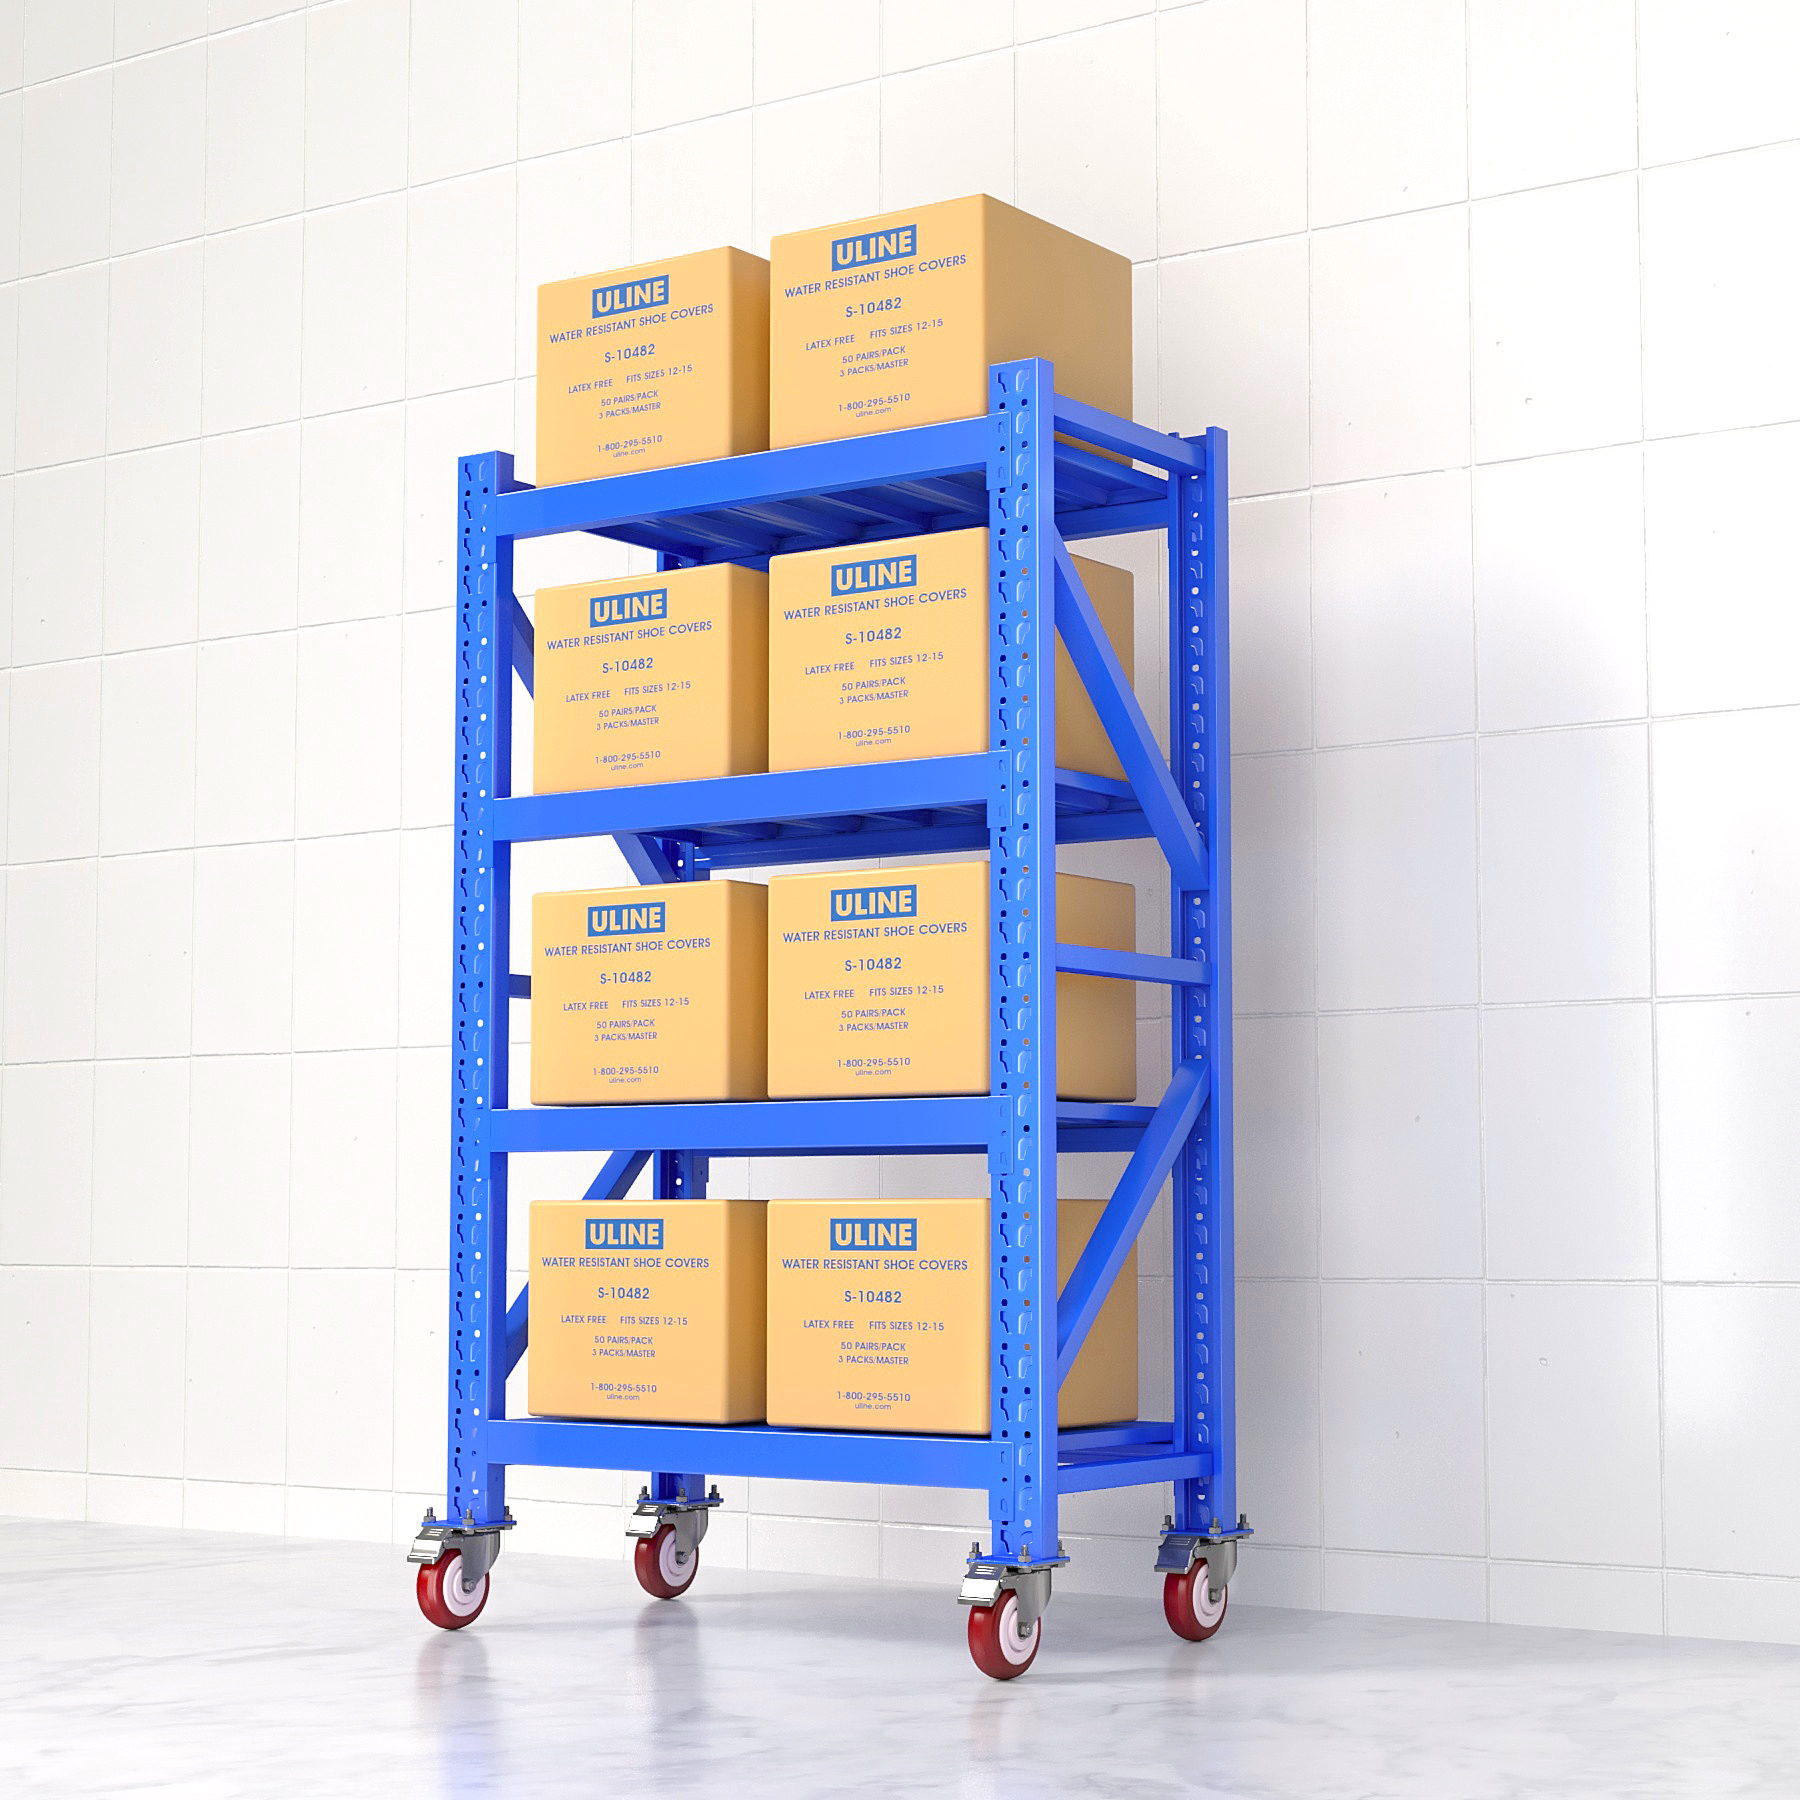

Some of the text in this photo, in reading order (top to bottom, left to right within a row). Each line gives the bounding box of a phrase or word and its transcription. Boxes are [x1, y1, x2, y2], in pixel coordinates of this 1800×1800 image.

[836, 230, 912, 265] ULINE
[784, 254, 966, 298] WATER RESISTANT SHOE COVERS
[596, 280, 665, 313] ULINE
[845, 297, 902, 318] S-10482
[549, 304, 714, 343] WATER RESISTANT SHOE COVERS
[806, 318, 944, 350] LATEX FREE FITS SIZES 12-15
[604, 344, 655, 362] S-10482
[842, 346, 905, 364] 50 PAIRS/PACK
[839, 358, 909, 378] 3 PACKS/MASTER
[567, 363, 693, 394] LATEX FREE FITS SIZES 12-15
[600, 390, 658, 407] 50 PAIRS/PACK
[839, 392, 911, 412] 1-800-295-5510
[606, 402, 661, 418] PACKS/MASTER
[855, 408, 893, 418] uline.com
[597, 435, 663, 452] 1-800-295-5510
[612, 448, 647, 458] uline.com
[836, 559, 912, 591] ULINE
[594, 593, 663, 623] ULINE
[784, 588, 966, 620] WATER RESISTANT SHOE COVERS
[547, 620, 713, 650] WATER RESISTANT SHOE COVERS
[845, 627, 902, 644] S-10482
[602, 657, 653, 674] S-10482
[805, 652, 944, 675] LATEX FREE FITS SIZES 12-15
[565, 680, 691, 702] LATEX FREE FITS SIZES 12-15
[842, 677, 906, 691] 50 PAIRS/PACK
[839, 690, 909, 704] 3 PACKS/MASTER
[598, 704, 656, 718] 50 PAIRS/PACK
[596, 717, 660, 731] 3 PACKS/MASTER
[838, 724, 911, 739] 1-800-295-5510
[855, 738, 892, 747] uline.com
[595, 750, 661, 764] 1-800-295-5510
[610, 762, 645, 771] uline.com
[835, 889, 912, 917] ULINE
[591, 907, 661, 933] ULINE
[783, 922, 968, 942] WATER RESISTANT SHOE COVERS
[544, 938, 711, 956] WATER RESISTANT SHOE COVERS
[845, 957, 902, 972] S-10482
[600, 970, 652, 984] S-10482
[804, 984, 944, 1000] LATEX FREE FITS SIZES 12-15
[563, 997, 689, 1011] LATEX FREE FITS SIZES 12-15
[841, 1008, 906, 1018] 50 PAIRS/PACK
[596, 1019, 654, 1029] 50 PAIRS/PACK
[839, 1021, 908, 1033] 3 PACKS/MASTER
[594, 1032, 657, 1042] 3 PACKS/MASTER
[837, 1057, 911, 1068] 1-800-295-5510
[593, 1066, 659, 1075] 1-800-295-5510
[608, 1075, 642, 1084] uline.com
[589, 1223, 660, 1245] ULINE
[835, 1223, 912, 1247] ULINE
[542, 1257, 710, 1268] WATER RESISTANT SHOE COVERS
[781, 1258, 968, 1271] WATER RESISTANT SHOE COVERS
[598, 1287, 650, 1300] S-10482
[844, 1290, 902, 1304] S-10482
[560, 1314, 688, 1326] LATEX FREE FITS SIZES 12-15
[803, 1320, 944, 1331] LATEX FREE FITS SIZES 12-15
[594, 1336, 653, 1344] 50 PAIRS/PACK
[841, 1341, 906, 1351] 50 PAIRS/PACK
[592, 1348, 656, 1358] 3 PACKS/MASTER
[838, 1355, 909, 1364] 3 PACKS/MASTER
[591, 1382, 657, 1392] 1-800-295-5510
[606, 1391, 640, 1400] uline.com
[837, 1392, 911, 1402] 1-800-295-5510
[854, 1402, 892, 1410] uline.com
